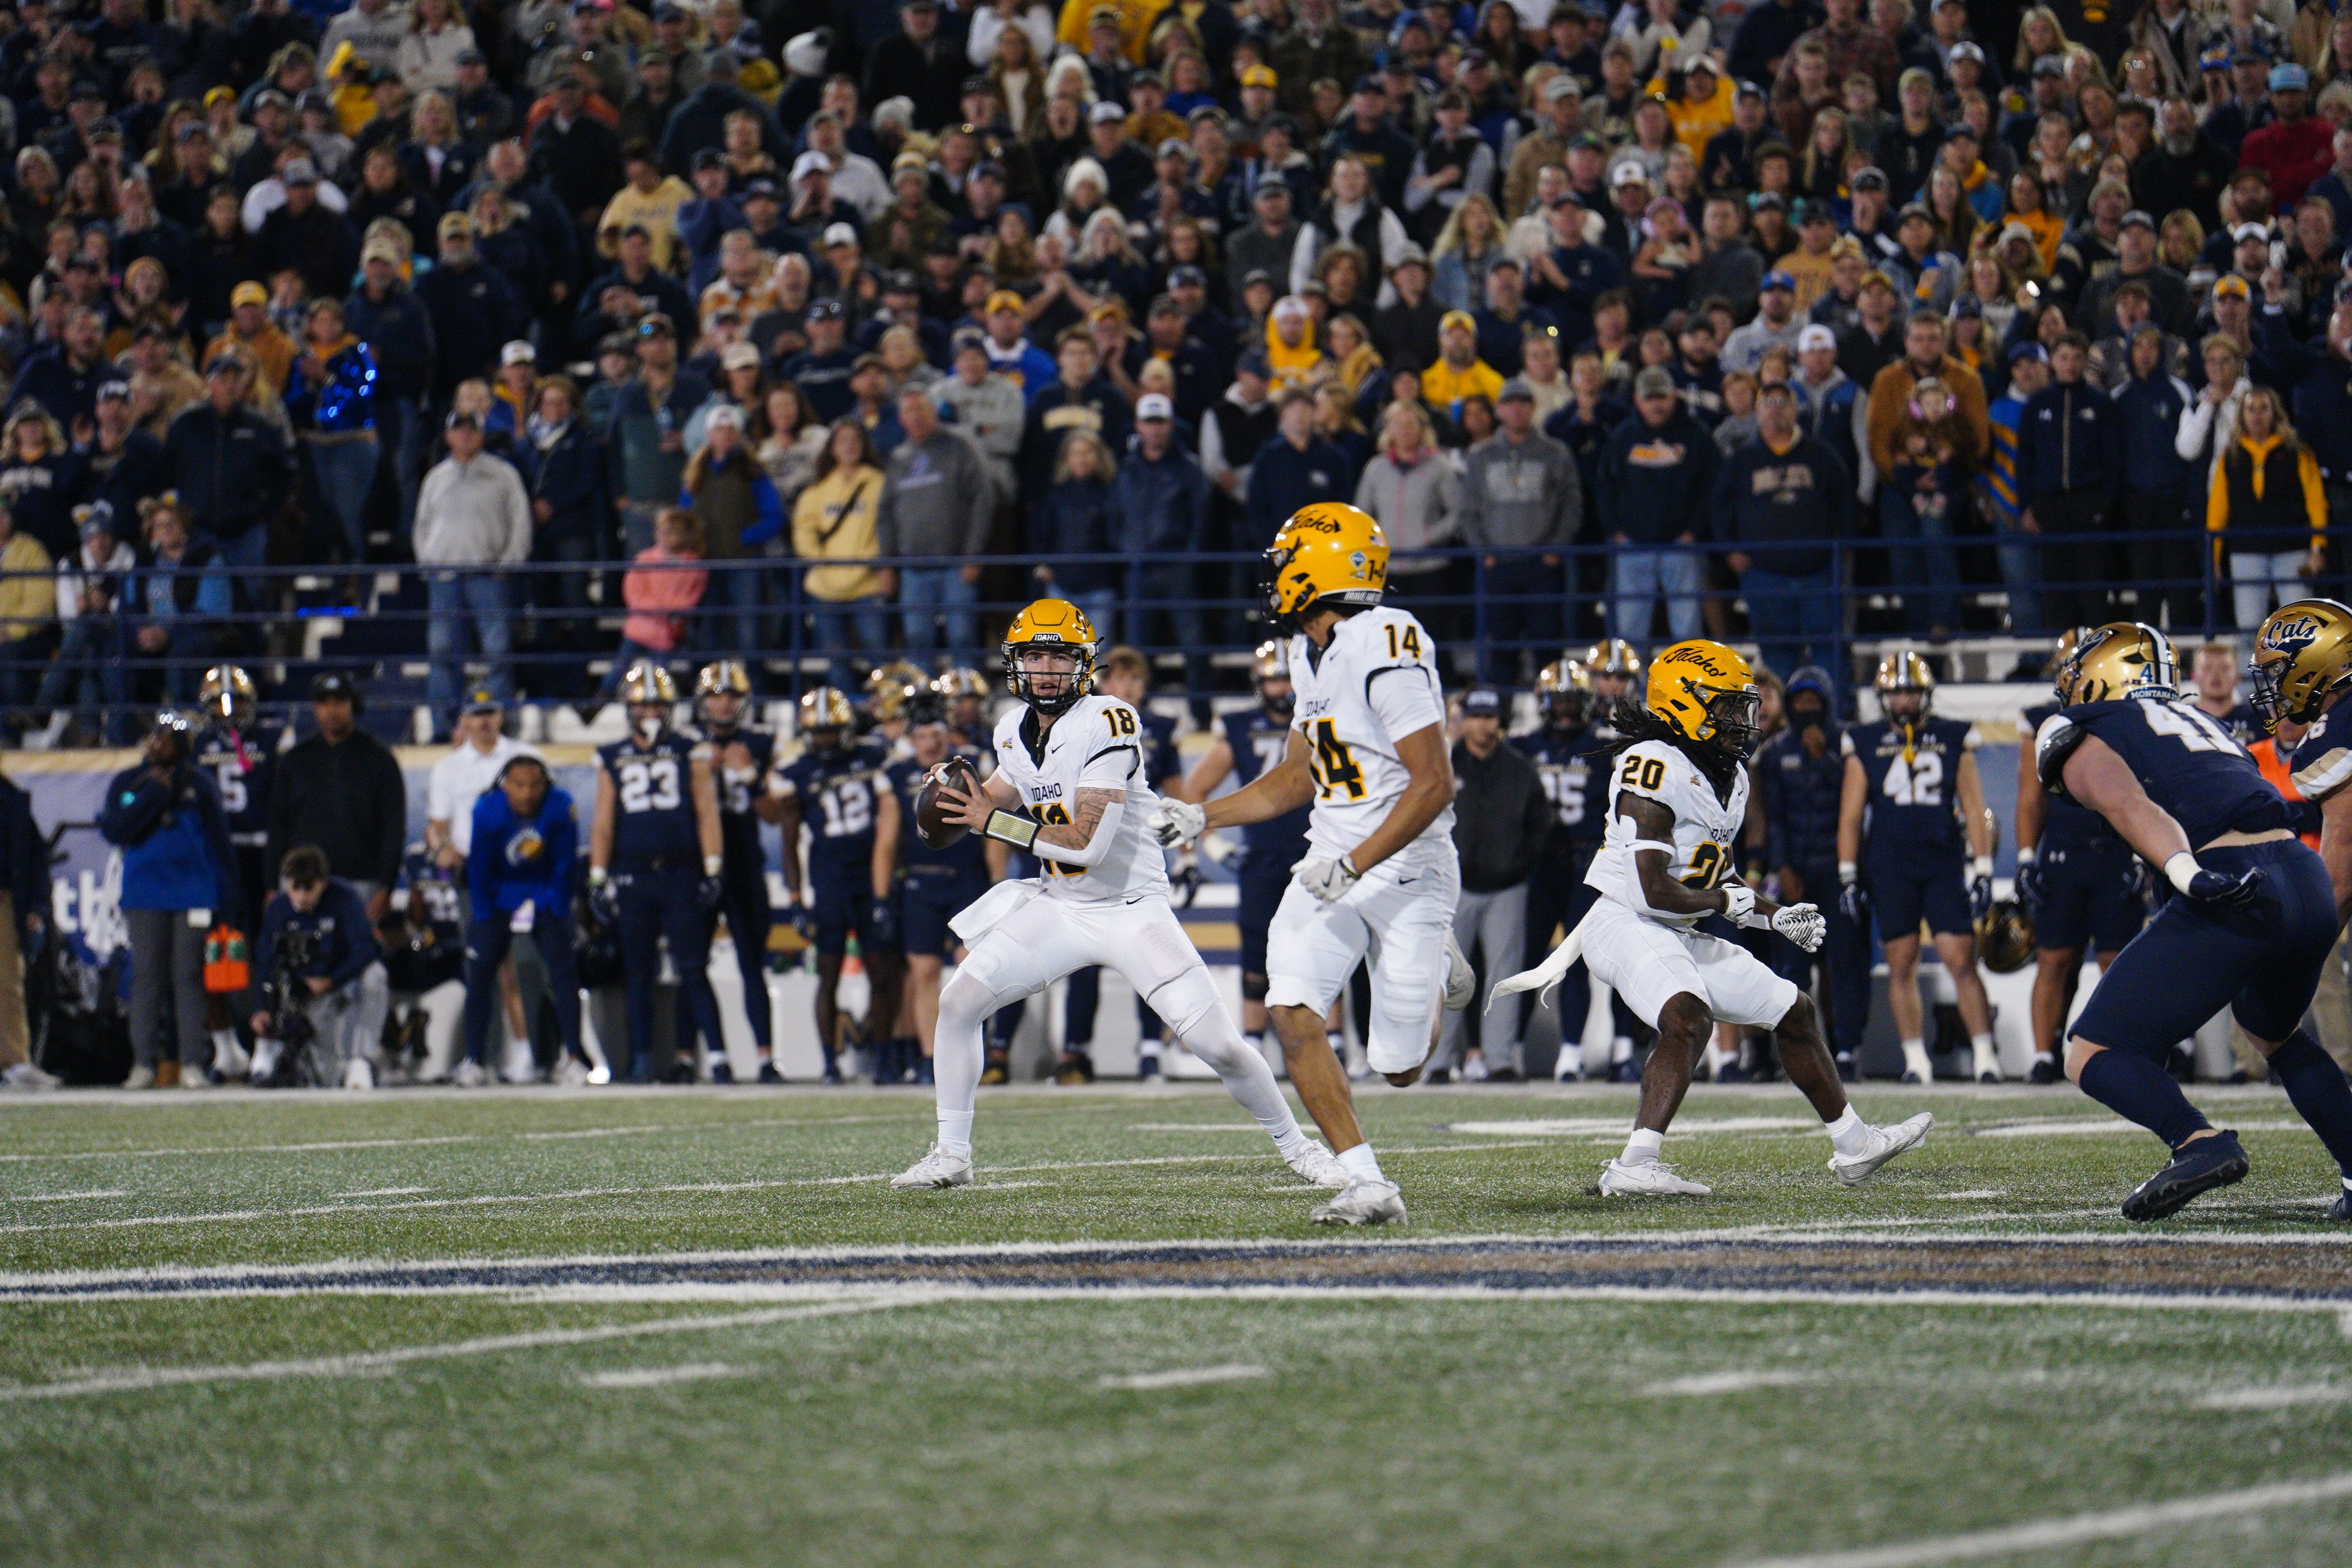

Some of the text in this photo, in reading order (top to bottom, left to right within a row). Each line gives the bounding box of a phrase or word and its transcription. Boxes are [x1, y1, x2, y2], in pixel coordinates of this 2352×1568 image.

[1384, 624, 1420, 659] 14
[2267, 616, 2320, 649] Cats
[1663, 647, 1727, 677] Idaho
[2140, 663, 2154, 684] 4
[2130, 689, 2171, 700] MONTANA
[1102, 708, 1136, 738] 18
[2138, 698, 2245, 758] 41
[216, 764, 247, 813] 5
[620, 758, 681, 813] 23
[1621, 755, 1667, 792] 20
[1882, 751, 1943, 805] 42
[819, 779, 871, 838] 12
[1031, 782, 1063, 802] IDAHO
